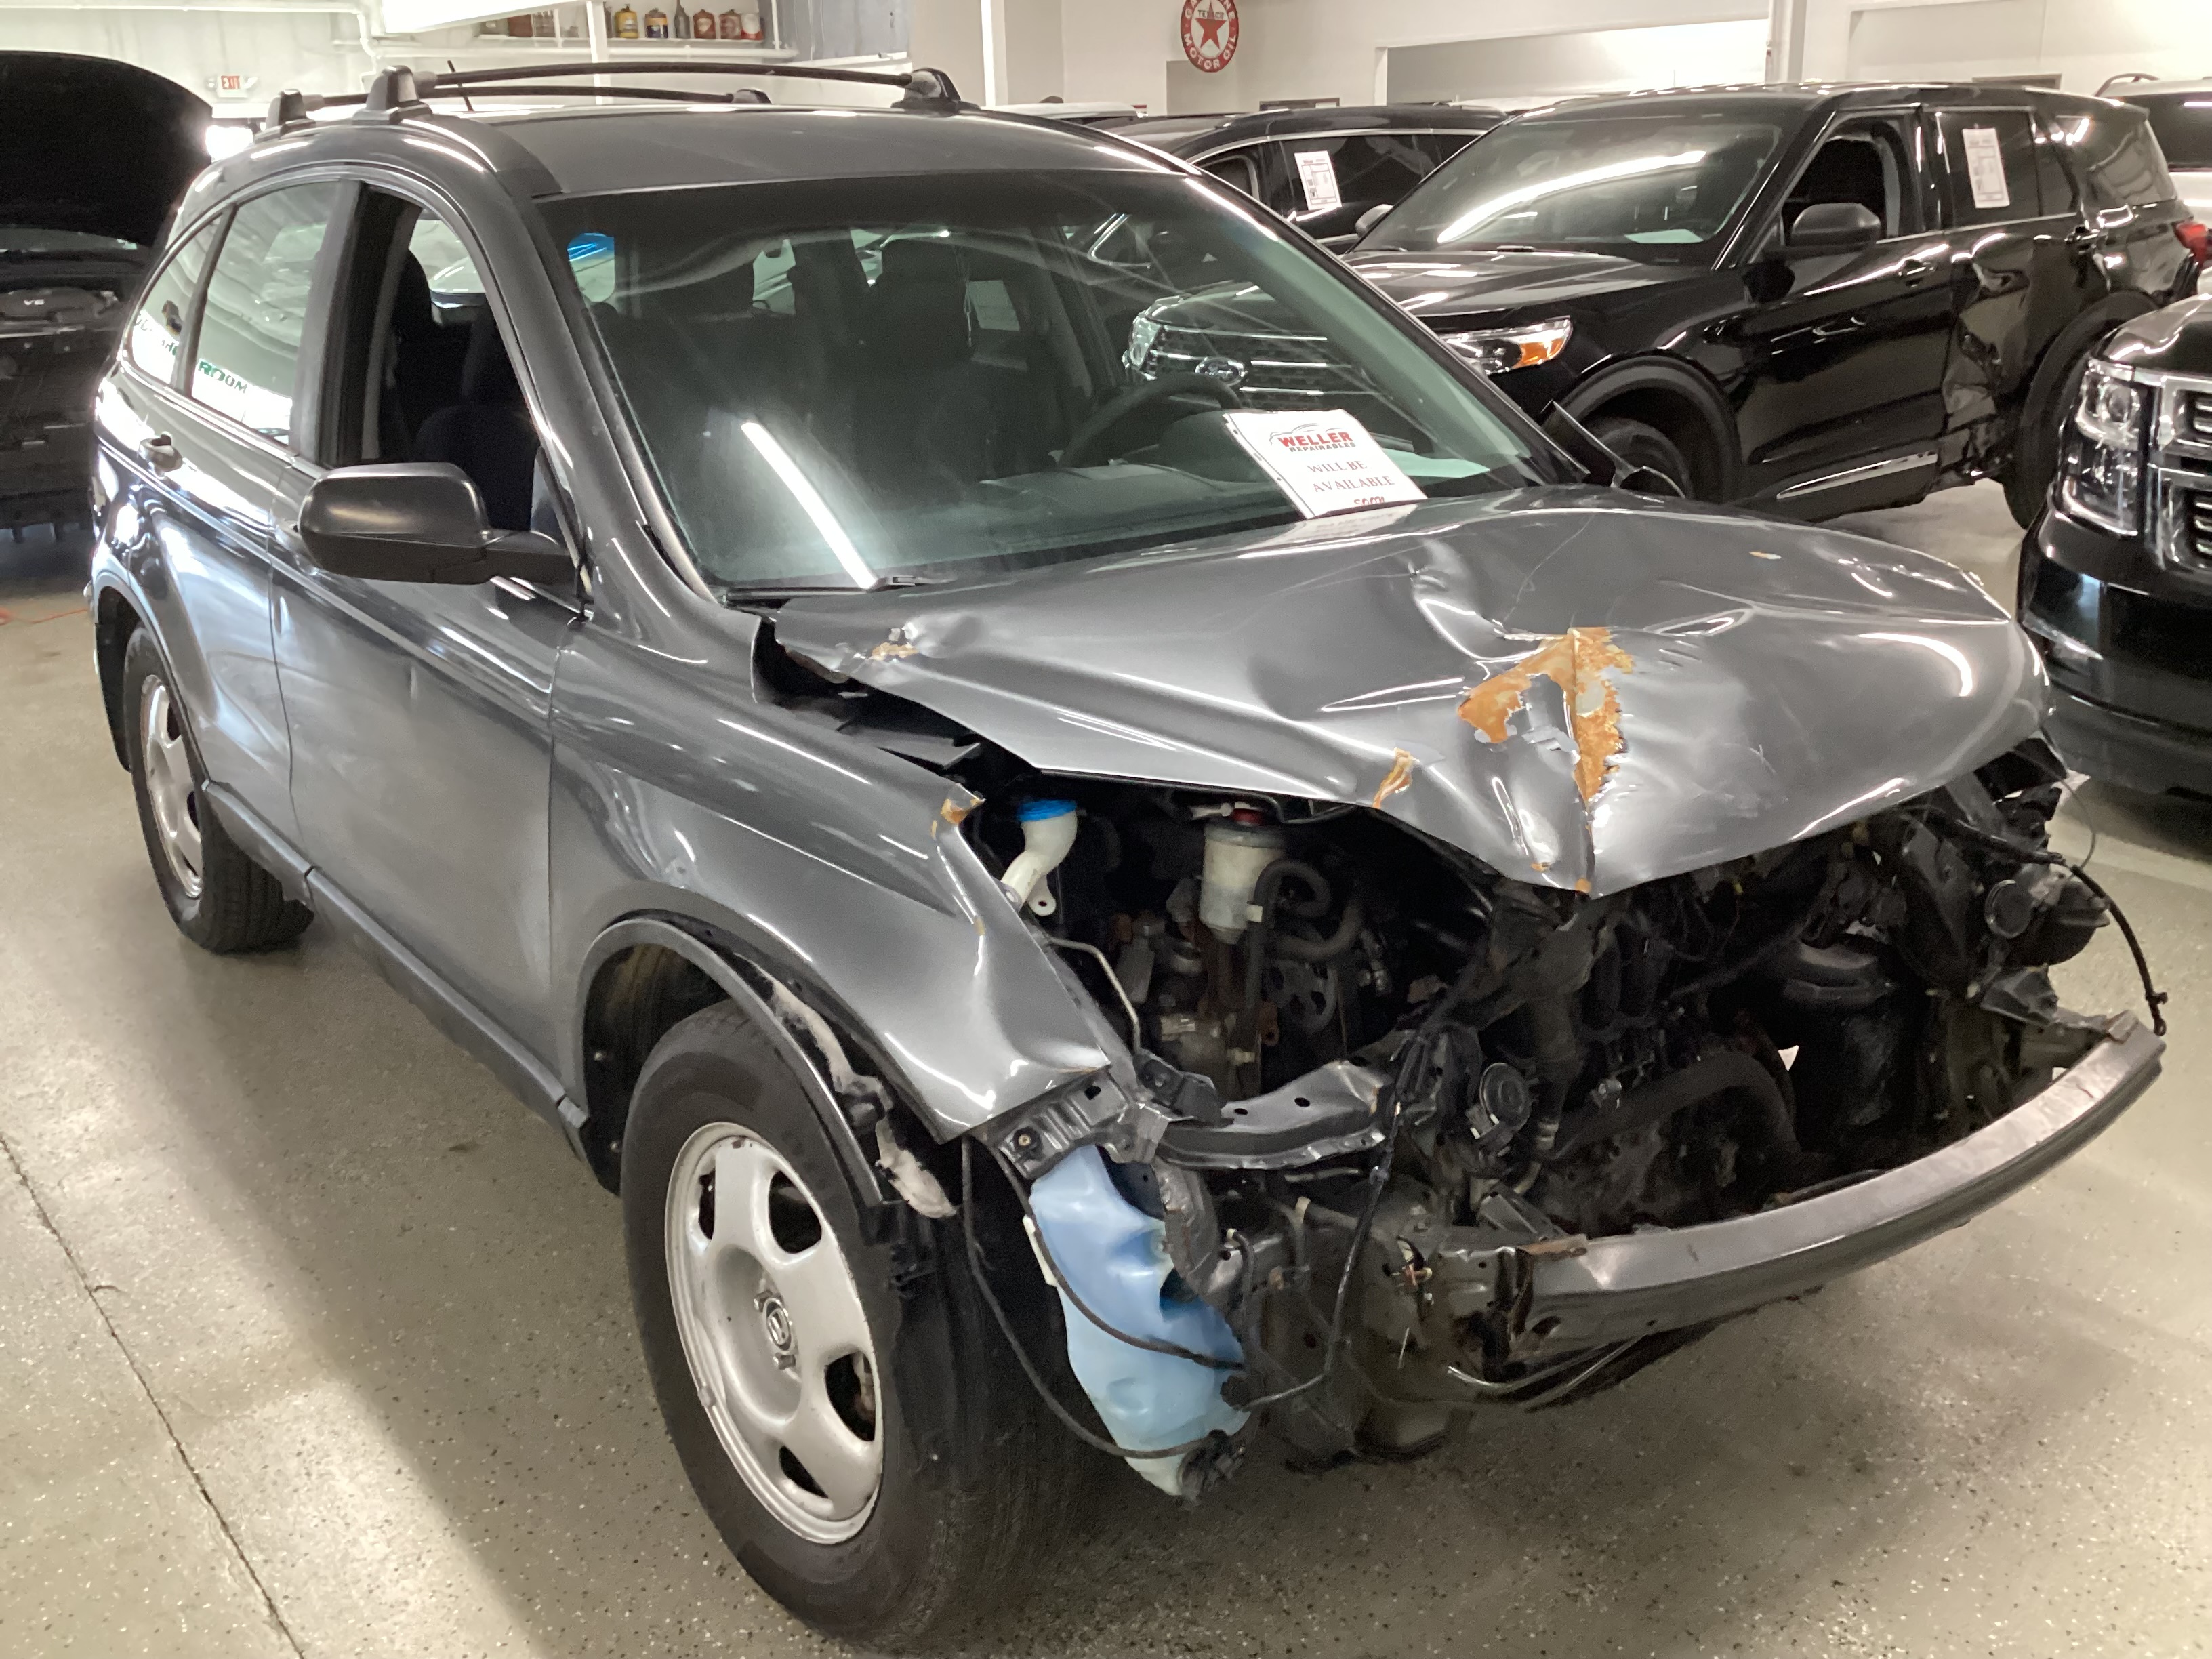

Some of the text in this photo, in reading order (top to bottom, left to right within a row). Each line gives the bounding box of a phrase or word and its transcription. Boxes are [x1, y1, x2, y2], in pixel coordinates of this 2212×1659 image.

[1184, 33, 1236, 69] MOTOR OIL
[197, 361, 248, 394] ROOM
[1277, 431, 1353, 447] WELLER
[1289, 441, 1356, 453] REPAIRABLES
[1307, 460, 1368, 473] WILL BE
[1312, 476, 1395, 493] AVAILABLE
